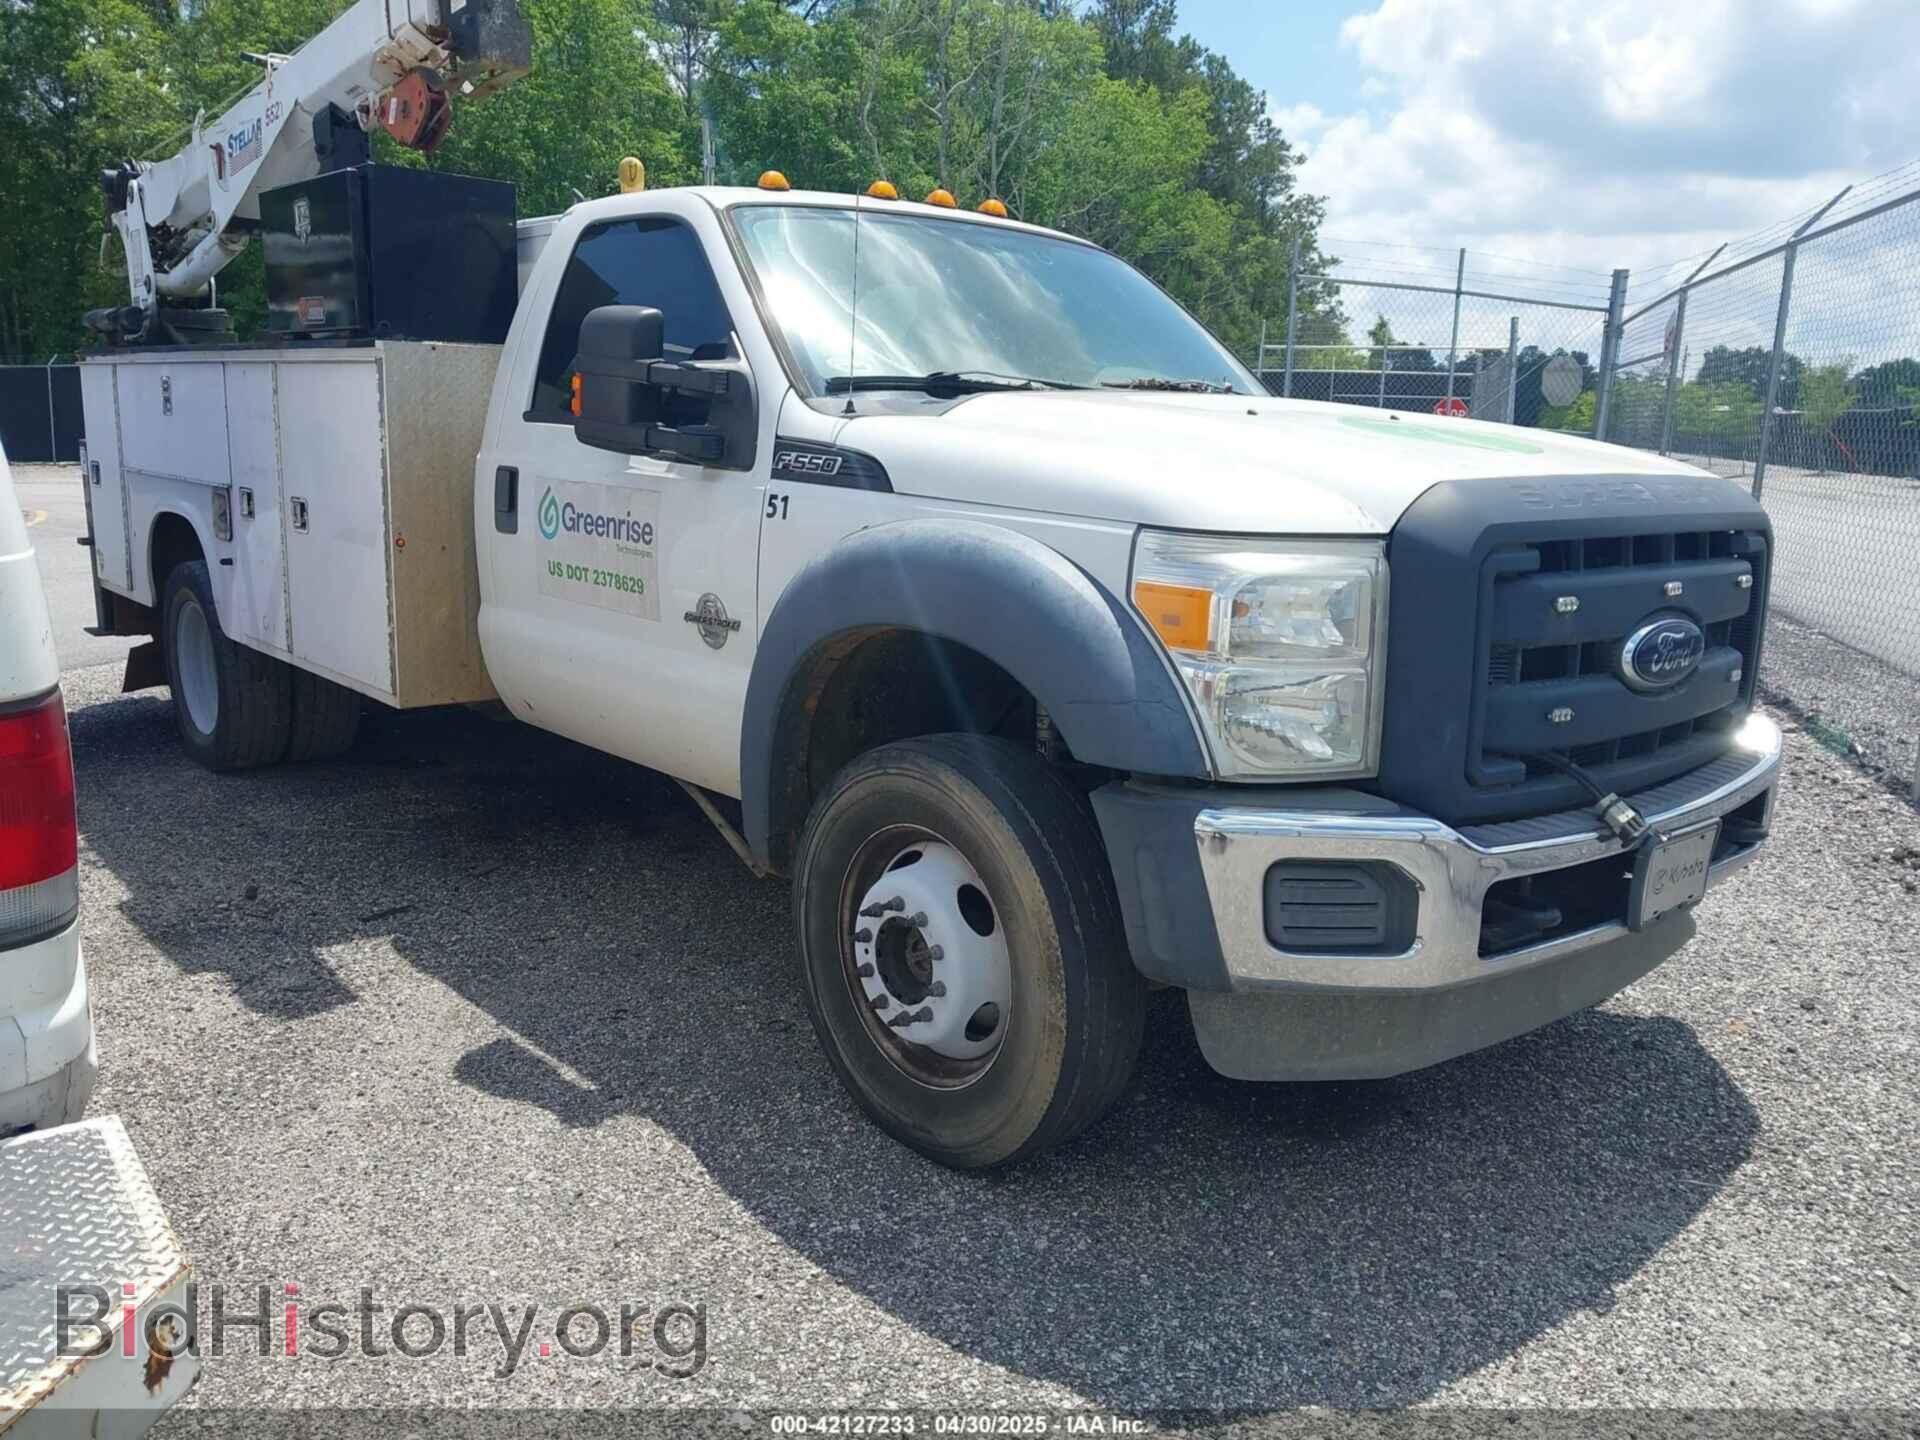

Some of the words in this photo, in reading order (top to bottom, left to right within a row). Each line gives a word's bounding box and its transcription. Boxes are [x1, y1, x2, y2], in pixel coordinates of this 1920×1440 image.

[228, 117, 262, 158] STELLAR
[775, 451, 842, 475] F-550
[562, 501, 653, 545] Greenrise
[766, 494, 789, 520] 51
[548, 560, 563, 577] US
[566, 564, 589, 582] DOT
[593, 569, 645, 594] 2378629
[1651, 631, 1698, 673] Ford
